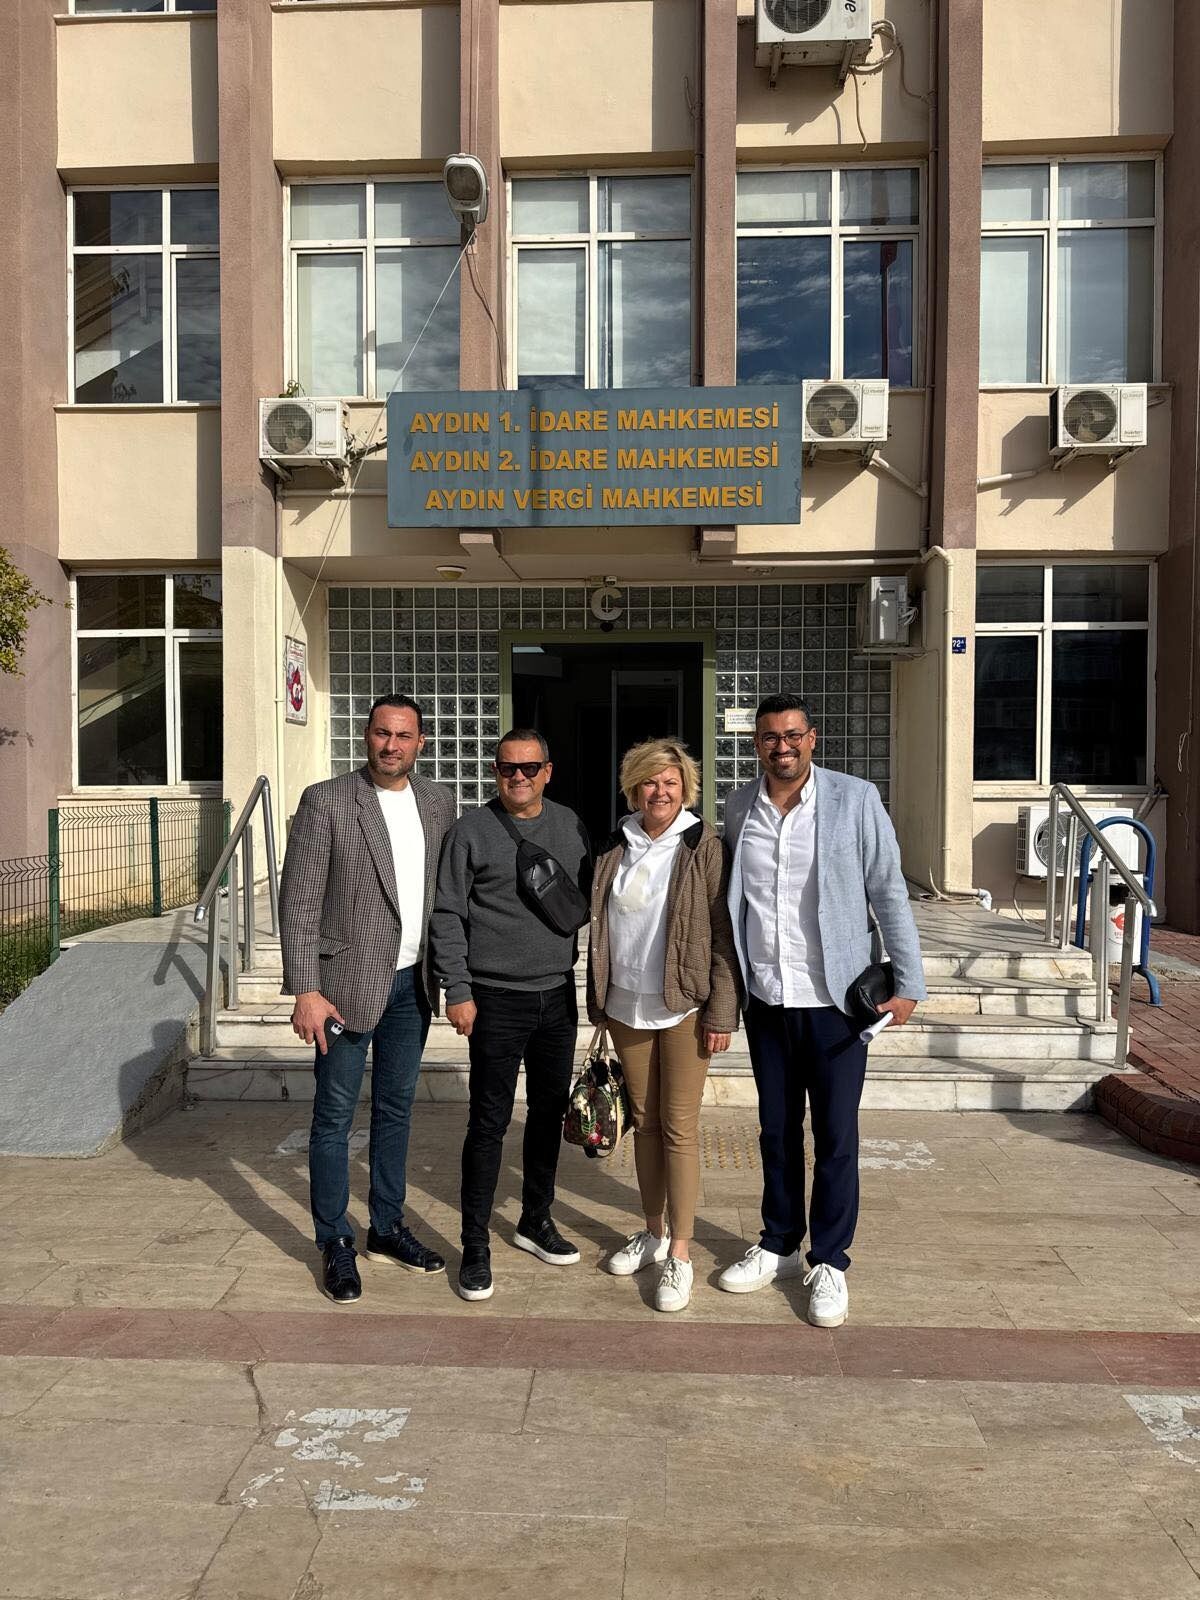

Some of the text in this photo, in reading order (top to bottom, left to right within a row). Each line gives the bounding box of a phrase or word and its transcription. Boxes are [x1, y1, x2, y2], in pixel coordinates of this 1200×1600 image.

[410, 402, 779, 433] AYDIN 1. İDARE MAHKEMESİ
[410, 441, 779, 471] AYDIN 2. İDARE MAHKEMESİ
[425, 480, 763, 510] AYDIN VERGİ MAHKEMESİ
